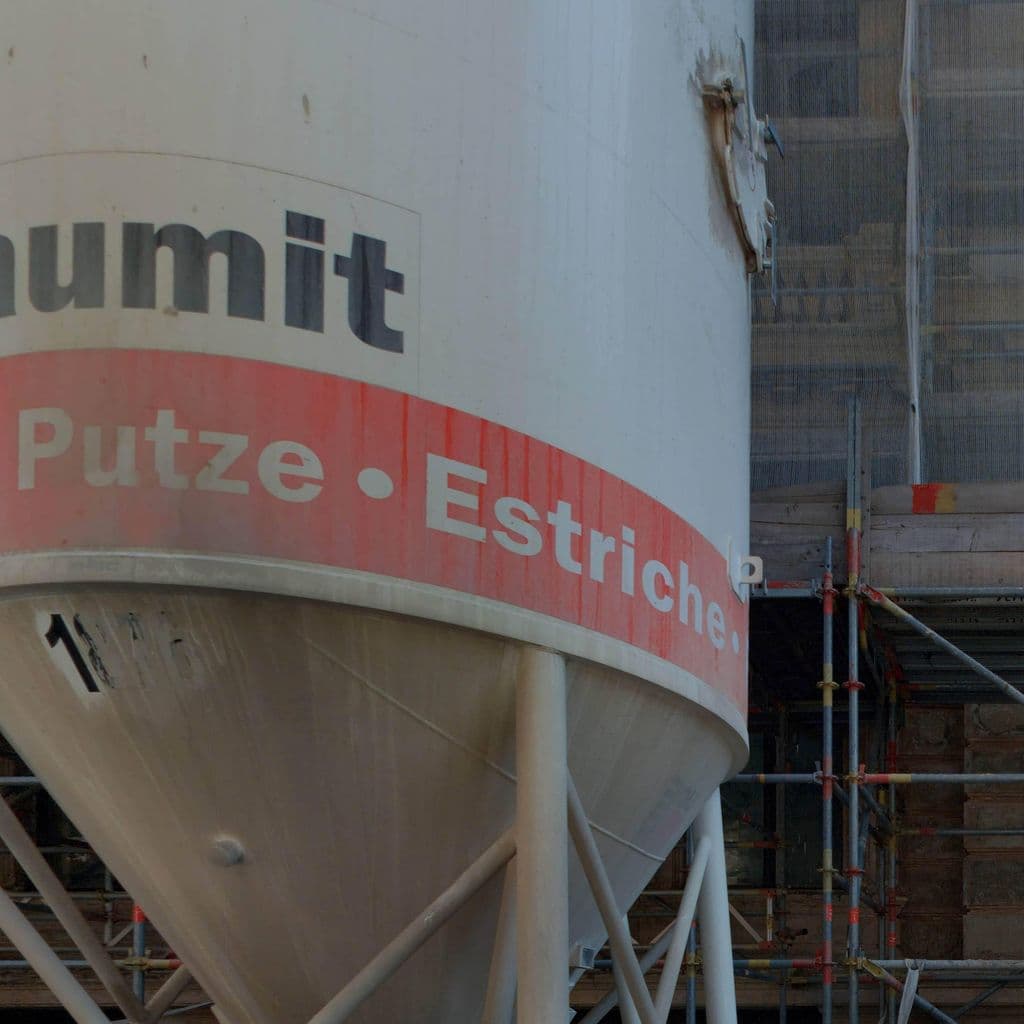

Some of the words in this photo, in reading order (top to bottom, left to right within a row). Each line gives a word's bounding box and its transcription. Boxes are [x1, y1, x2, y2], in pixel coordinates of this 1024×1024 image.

[0, 210, 404, 354] umit
[17, 407, 325, 503] Putze
[426, 452, 726, 650] Estriche
